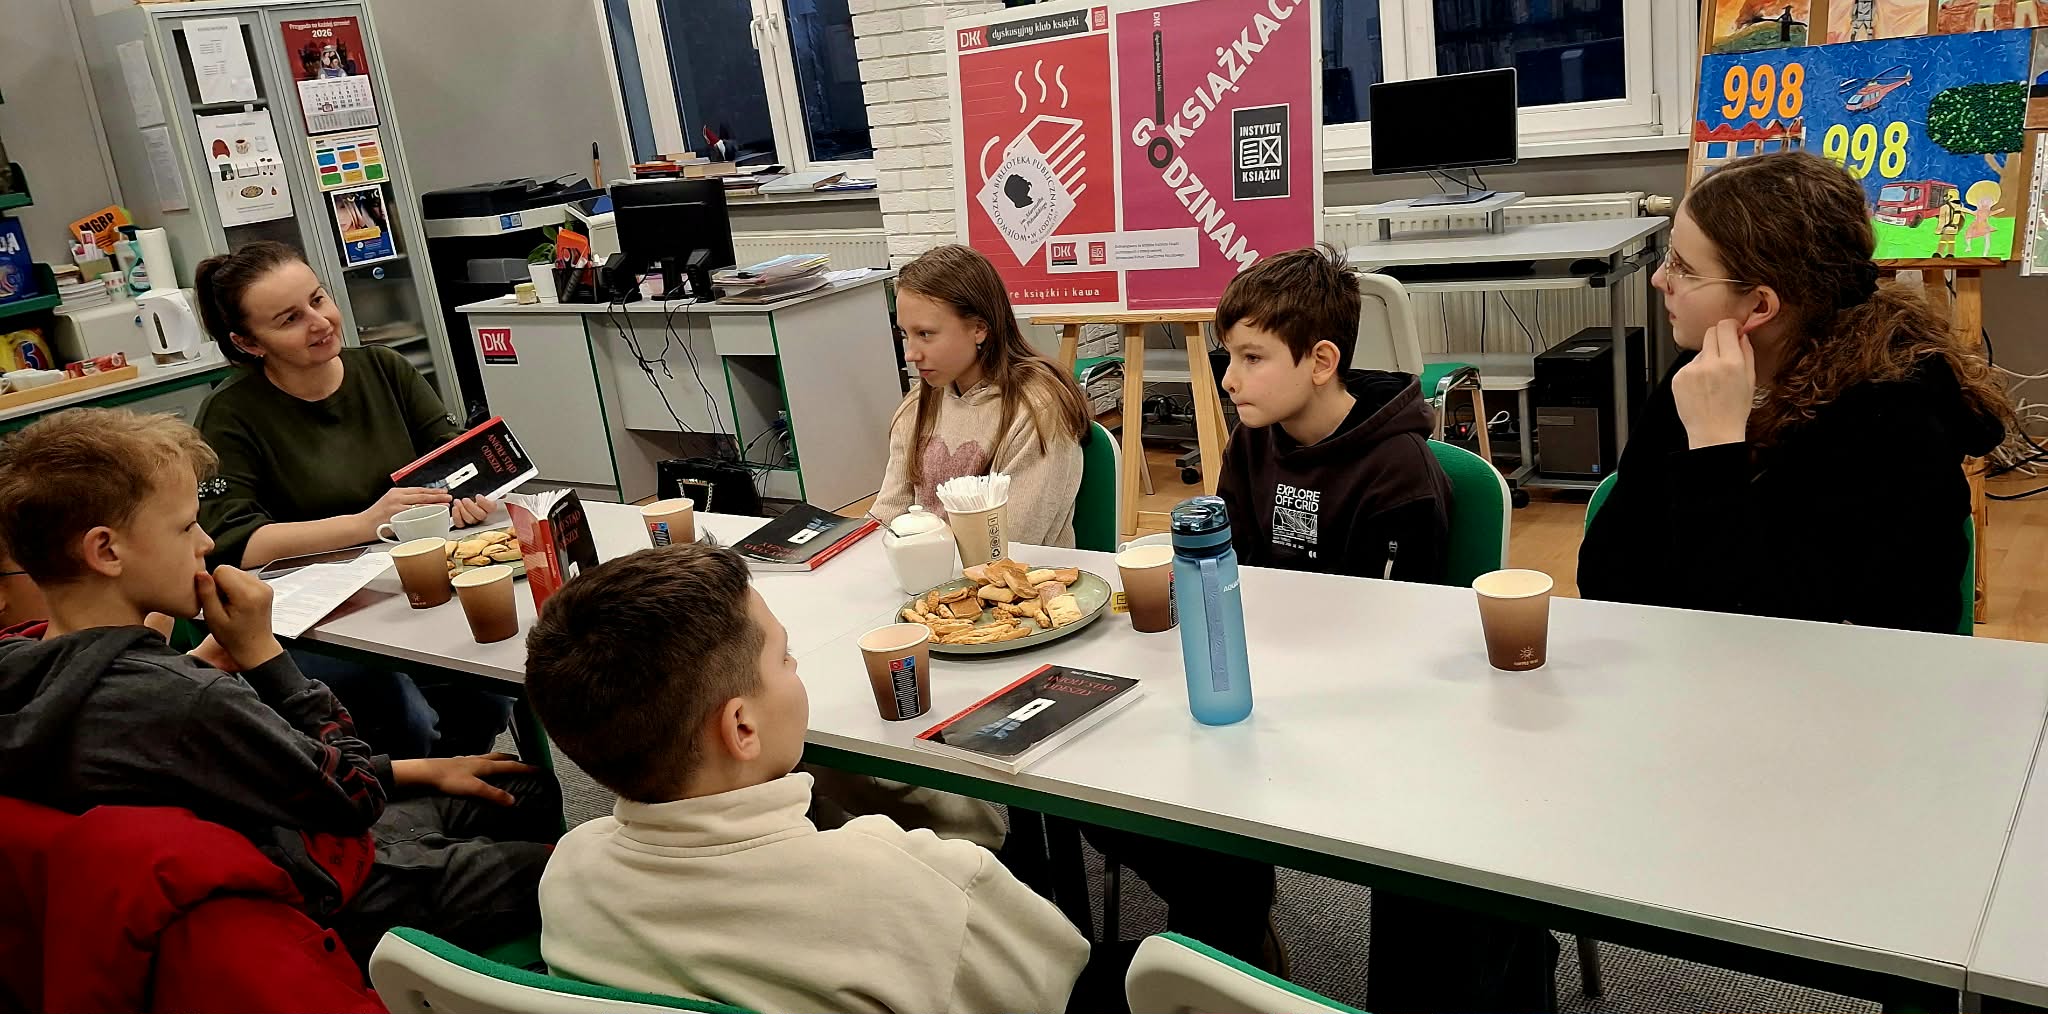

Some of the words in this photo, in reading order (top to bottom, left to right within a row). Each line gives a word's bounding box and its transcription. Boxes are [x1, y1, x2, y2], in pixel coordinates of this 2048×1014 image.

[312, 28, 332, 37] 2026
[992, 25, 1033, 40] dyskusyjny
[1035, 21, 1050, 33] klub
[1053, 16, 1079, 29] książki
[1722, 63, 1805, 119] 998
[1240, 123, 1281, 137] INSTYTUT
[1823, 121, 1909, 179] 998
[994, 156, 1031, 188] BIBLIOTEKA
[1032, 158, 1056, 208] PUBLICZNA
[1242, 168, 1281, 183] KSIĄŻKI
[1024, 288, 1059, 299] książki
[1064, 288, 1068, 297] i
[1072, 288, 1100, 297] kawa
[1276, 484, 1320, 502] EXPLORE
[1275, 494, 1294, 507] OFF
[1294, 500, 1319, 512] GRID
